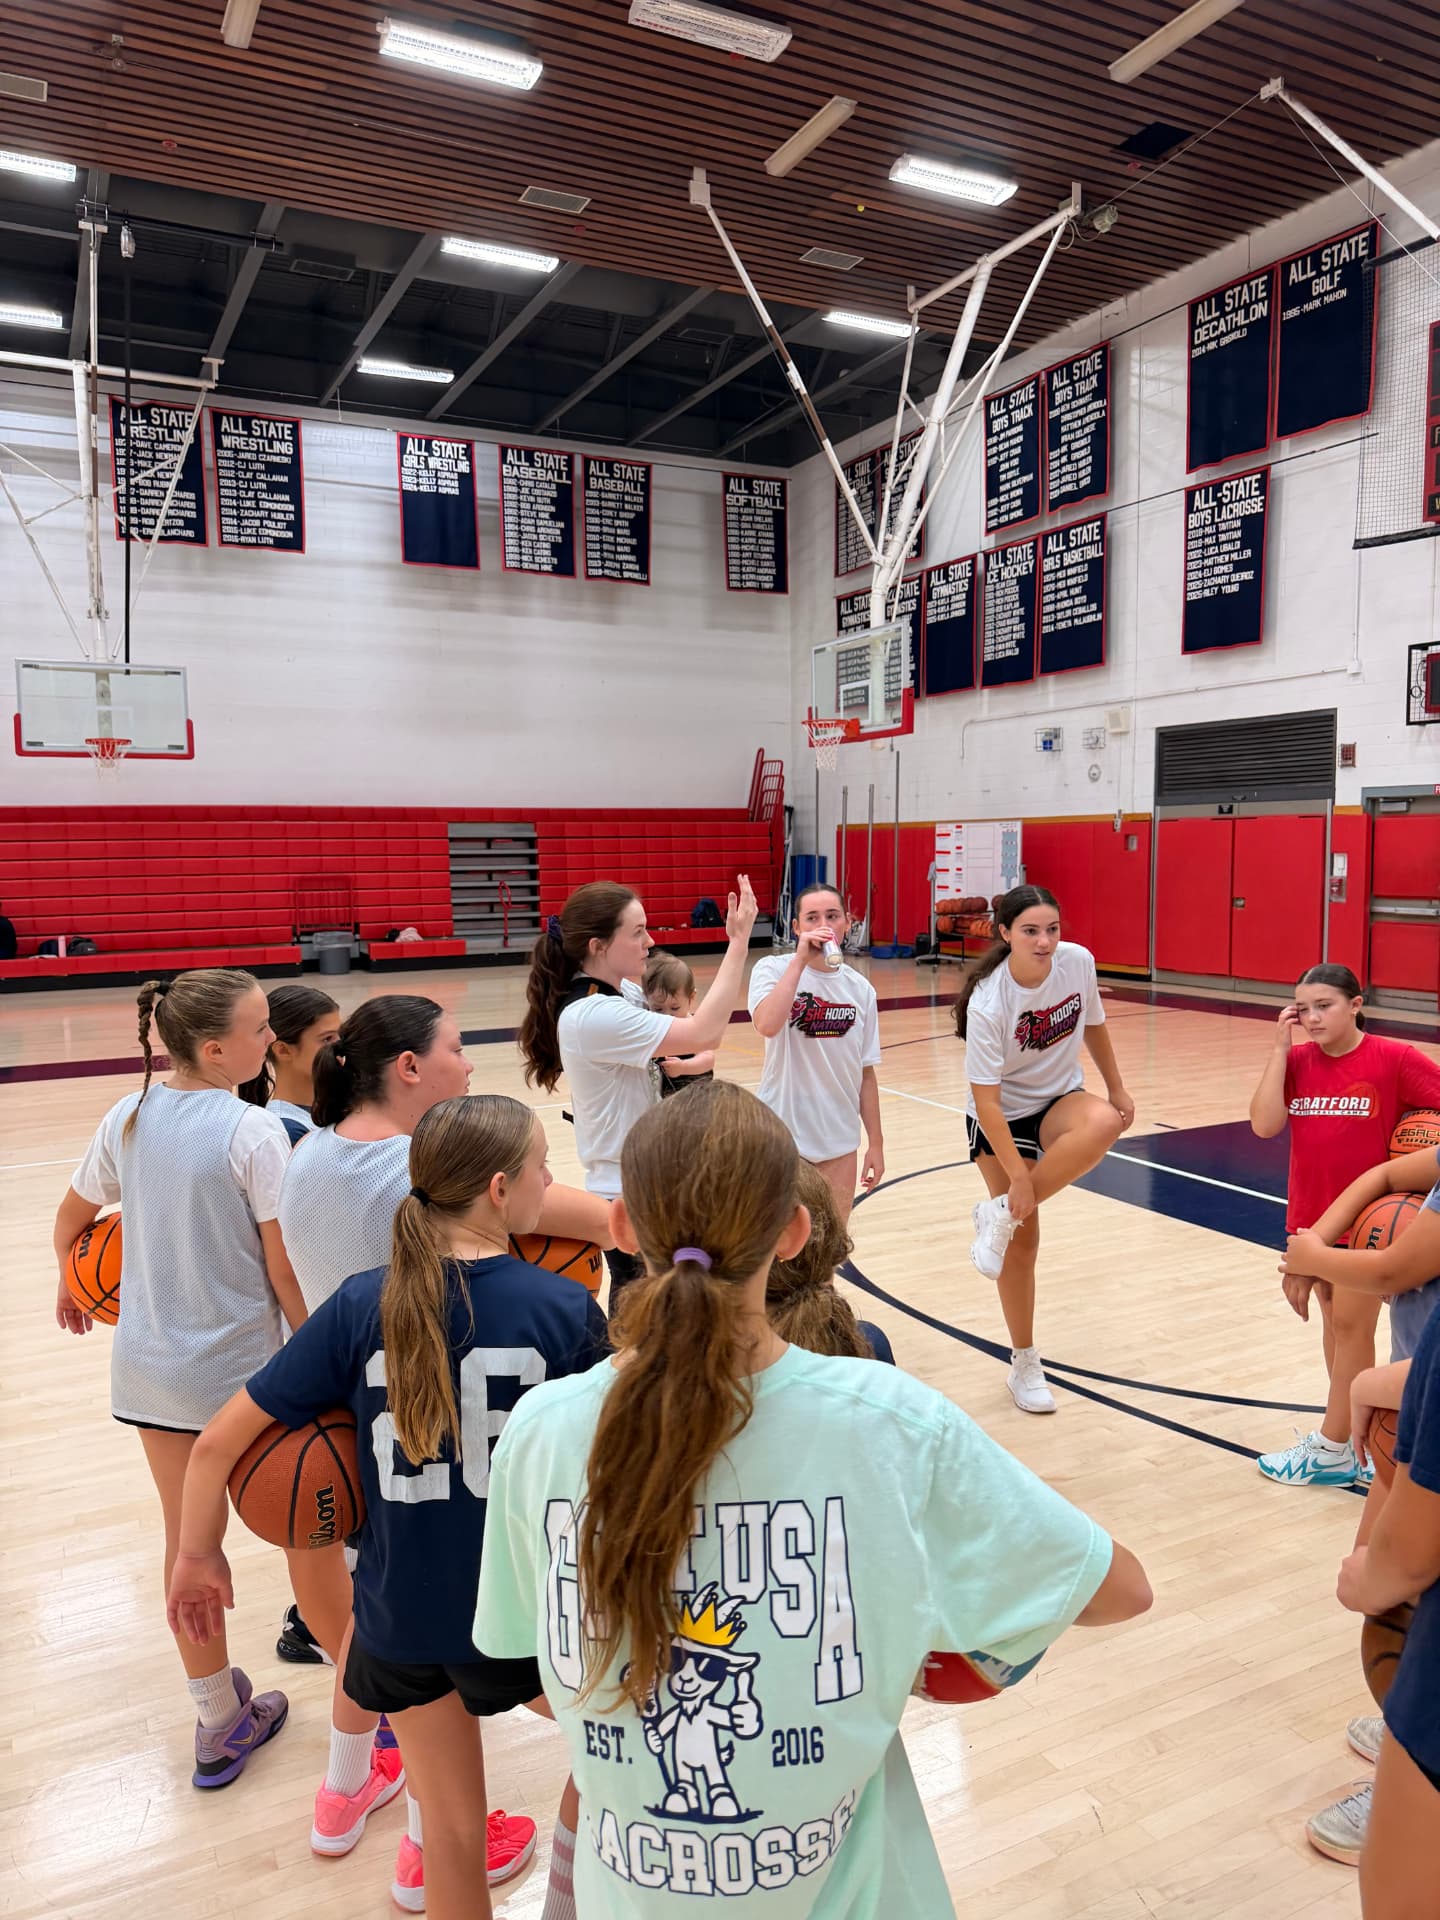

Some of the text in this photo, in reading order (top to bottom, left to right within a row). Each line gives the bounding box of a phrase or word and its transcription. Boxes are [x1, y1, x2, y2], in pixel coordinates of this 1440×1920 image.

[1289, 231, 1369, 286] ALL STATE
[1312, 269, 1342, 296] GOLF
[1196, 275, 1268, 325] ALL STATE
[1323, 287, 1346, 304] MAHON
[1194, 300, 1268, 344] DECATHLON
[1052, 350, 1102, 390] ALL STATE
[990, 381, 1035, 418] ALL STATE
[1055, 373, 1098, 406] BOYS TRACK
[119, 405, 193, 429] ALL STATE
[221, 415, 292, 440] ALL STATE
[992, 402, 1033, 433] BOYS TRACK
[221, 434, 293, 454] WRESTLING
[406, 437, 466, 460] ALL STATE
[248, 462, 264, 470] LUTH
[403, 454, 469, 473] GIRLS WRESTLING
[506, 448, 568, 470] ALL STATE
[589, 460, 646, 482] ALL STATE
[249, 481, 266, 489] LUTH
[256, 472, 288, 482] CALLAHAN
[502, 463, 571, 484] BASEBALL
[257, 491, 290, 501] CALLAHAN
[589, 477, 644, 495] BASEBALL
[729, 477, 781, 496] ALL STATE
[1193, 473, 1261, 511] ALL-STATE
[725, 493, 784, 510] SOFTBALL
[1188, 495, 1264, 529] BOYS LACROSSE
[257, 536, 274, 544] LUTH
[1046, 522, 1100, 554] ALL STATE
[988, 542, 1034, 570] ALL STATE
[1043, 542, 1104, 572] GIRLS BASKETBALL
[1230, 549, 1251, 561] MILLER
[930, 559, 972, 587] ALL STATE
[986, 559, 1034, 584] ICE HOCKEY
[932, 578, 968, 599] GYMNASTICS
[1221, 583, 1239, 594] YOUNG
[840, 599, 853, 617] ALL
[854, 593, 870, 613] STAT
[810, 1020, 848, 1031] NATION
[1040, 1014, 1077, 1044] NATION
[1289, 1096, 1371, 1110] STRATFORD
[366, 1347, 547, 1503] 26
[716, 1496, 864, 1704] USA
[583, 1722, 825, 1768] EST. 2016
[592, 1790, 855, 1897] ACROSSE
